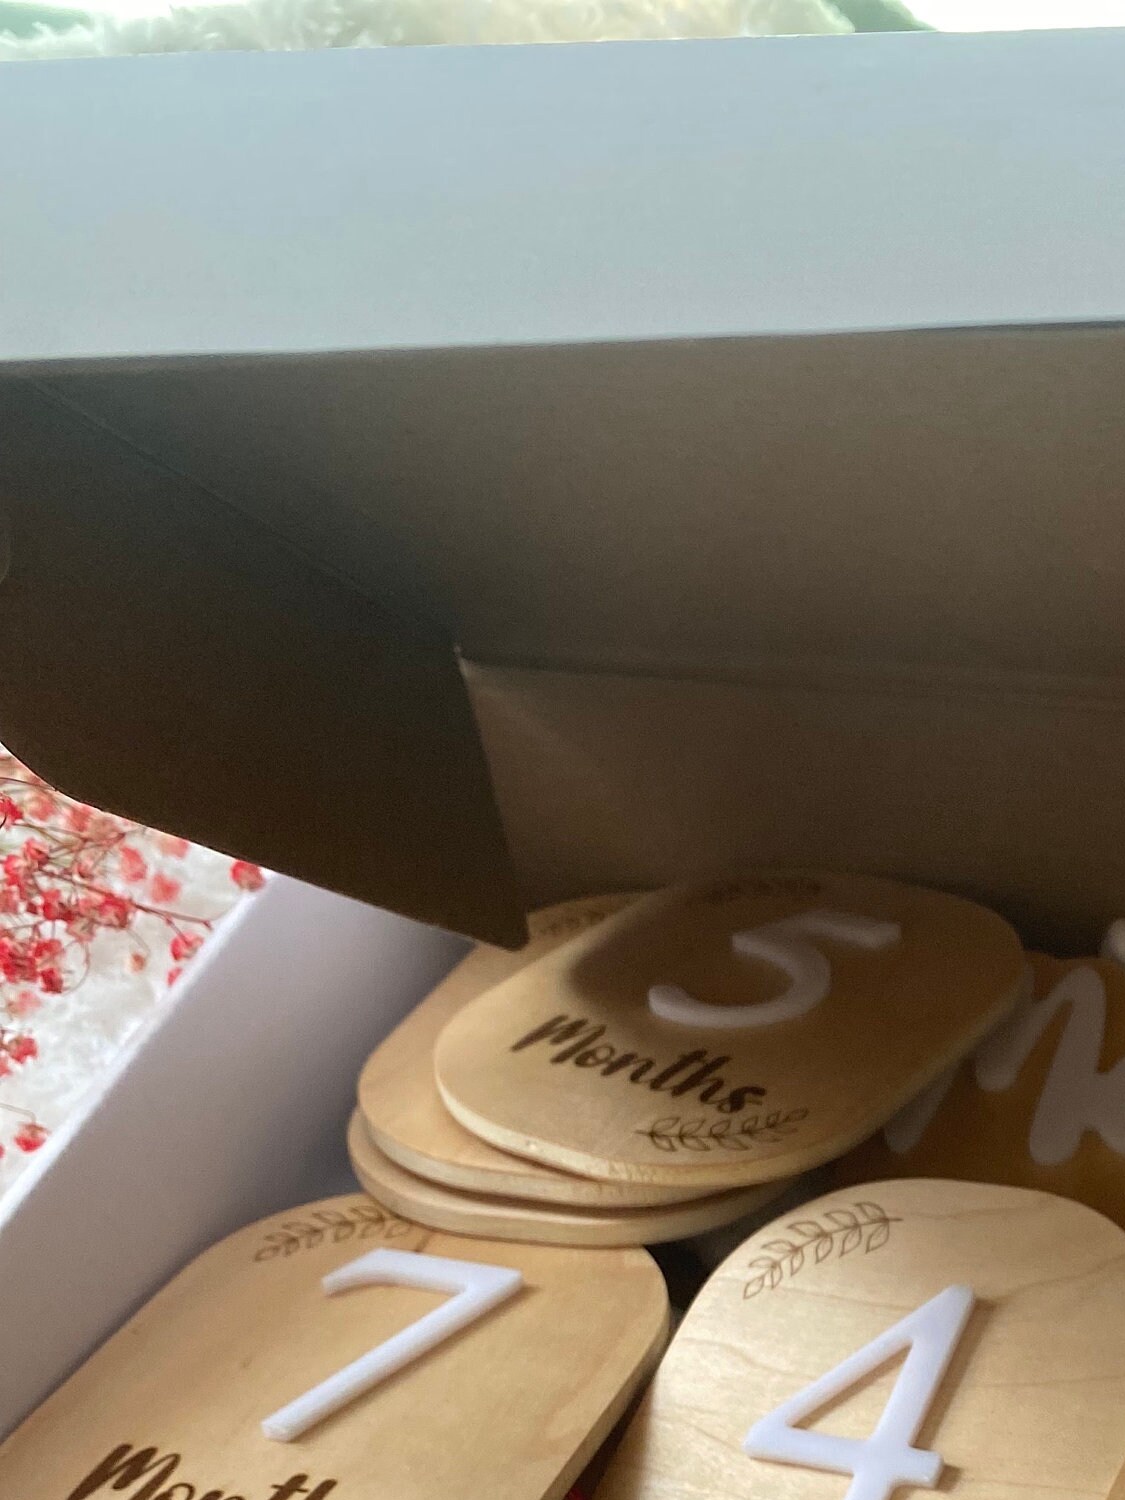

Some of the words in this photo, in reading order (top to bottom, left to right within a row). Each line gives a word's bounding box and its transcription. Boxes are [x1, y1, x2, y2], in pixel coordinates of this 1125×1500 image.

[646, 911, 902, 1029] 5
[510, 1014, 768, 1114] Months
[260, 1246, 524, 1444] 7
